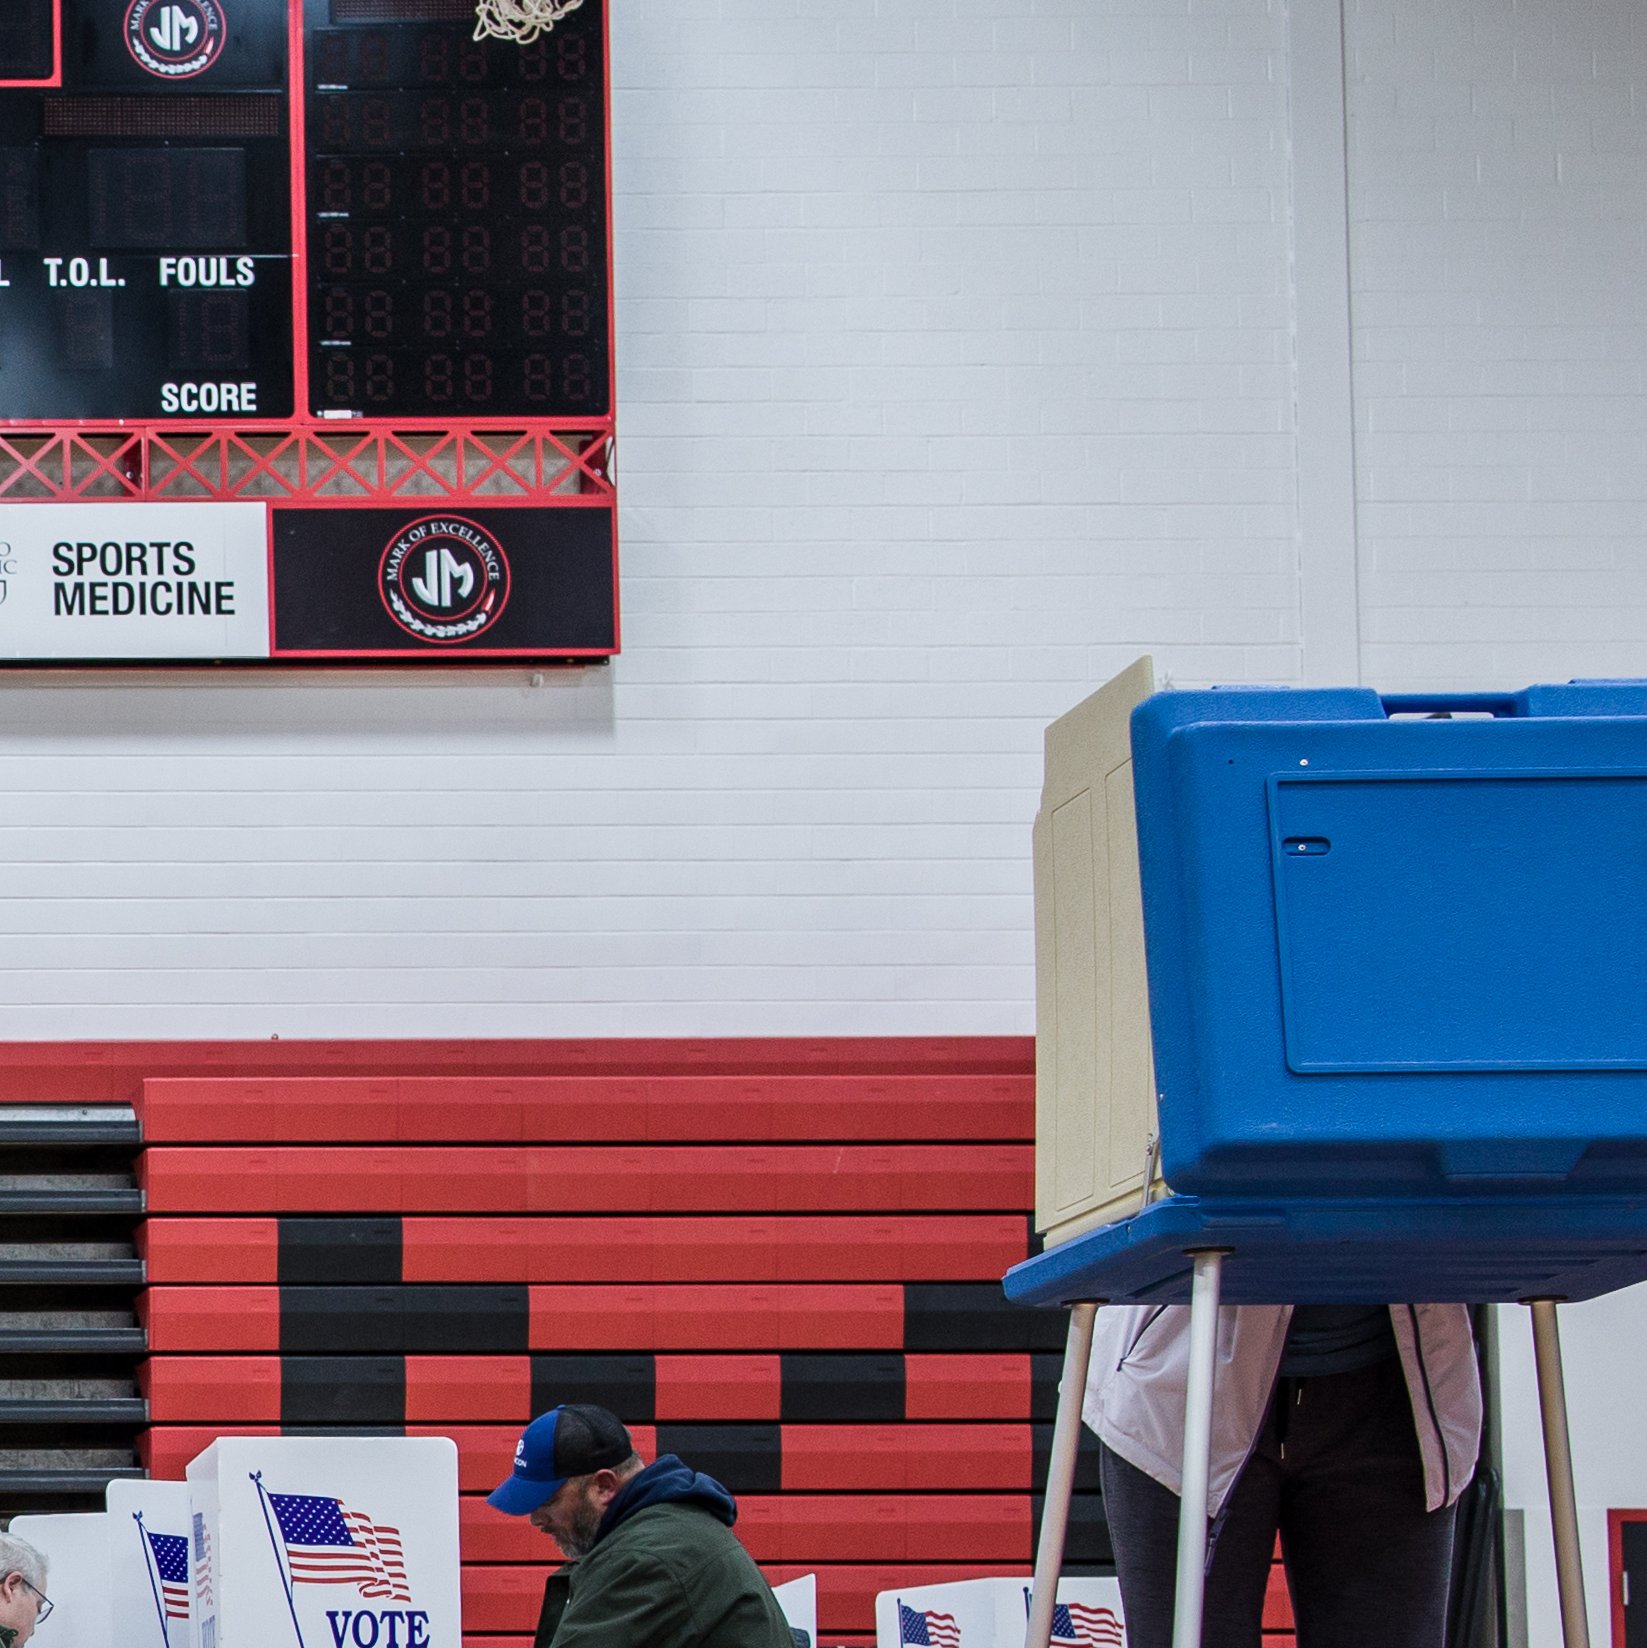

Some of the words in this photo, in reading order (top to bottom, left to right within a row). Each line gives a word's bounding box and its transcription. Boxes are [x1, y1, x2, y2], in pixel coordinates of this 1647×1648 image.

[149, 5, 199, 51] JM
[43, 258, 126, 287] T.O.L.
[159, 257, 255, 287] FOULS
[161, 383, 257, 412] SCORE
[52, 541, 196, 577] SPORTS
[386, 538, 411, 581] MARK
[408, 525, 428, 542] OF
[430, 521, 500, 581] EXCELLENCE
[411, 548, 474, 608] JM
[53, 581, 236, 616] MEDICINE
